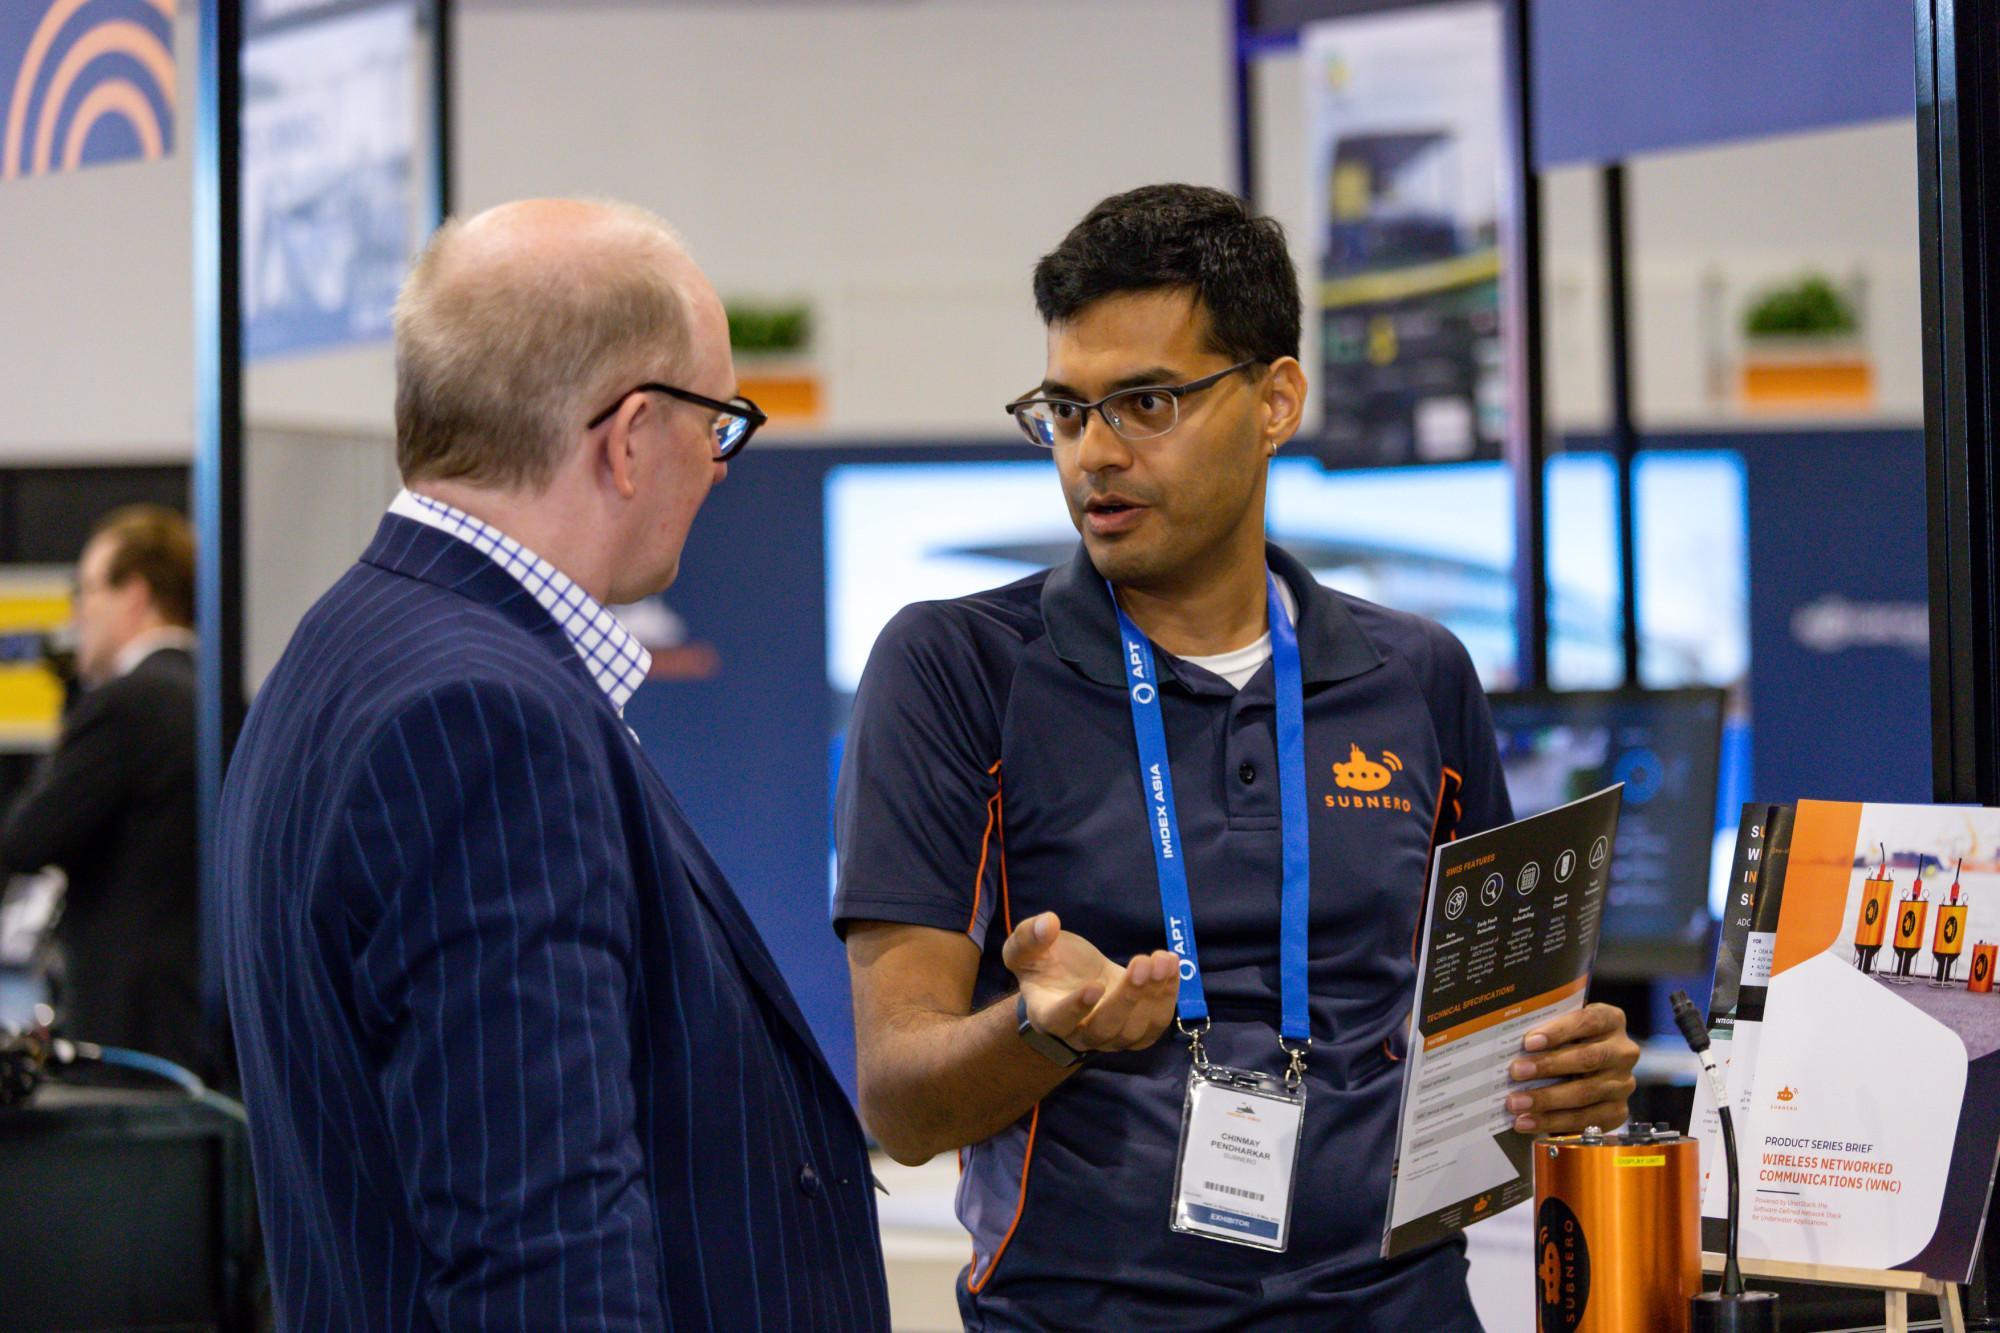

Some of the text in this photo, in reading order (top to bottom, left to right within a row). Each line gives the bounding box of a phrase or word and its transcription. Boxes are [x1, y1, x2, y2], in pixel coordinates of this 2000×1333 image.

[1128, 641, 1145, 679] APT
[1150, 763, 1174, 858] IMDEX ASIA
[1324, 795, 1412, 812] SUBNERO
[1170, 916, 1186, 955] APT
[1427, 983, 1517, 1024] TECHNICAL SPECIFICATIONS
[1210, 1140, 1271, 1160] PENDHARKAR
[1221, 1132, 1261, 1147] CHINMAY
[1765, 1136, 1874, 1153] PRODUCT SERIES BRIEF
[1762, 1153, 1893, 1175] WIRELESS NETWORKED
[1760, 1169, 1902, 1194] COMMUNICATIONS (WNC)
[1210, 1213, 1251, 1228] EXHIBITOR
[1564, 1219, 1576, 1323] SUBNERO
